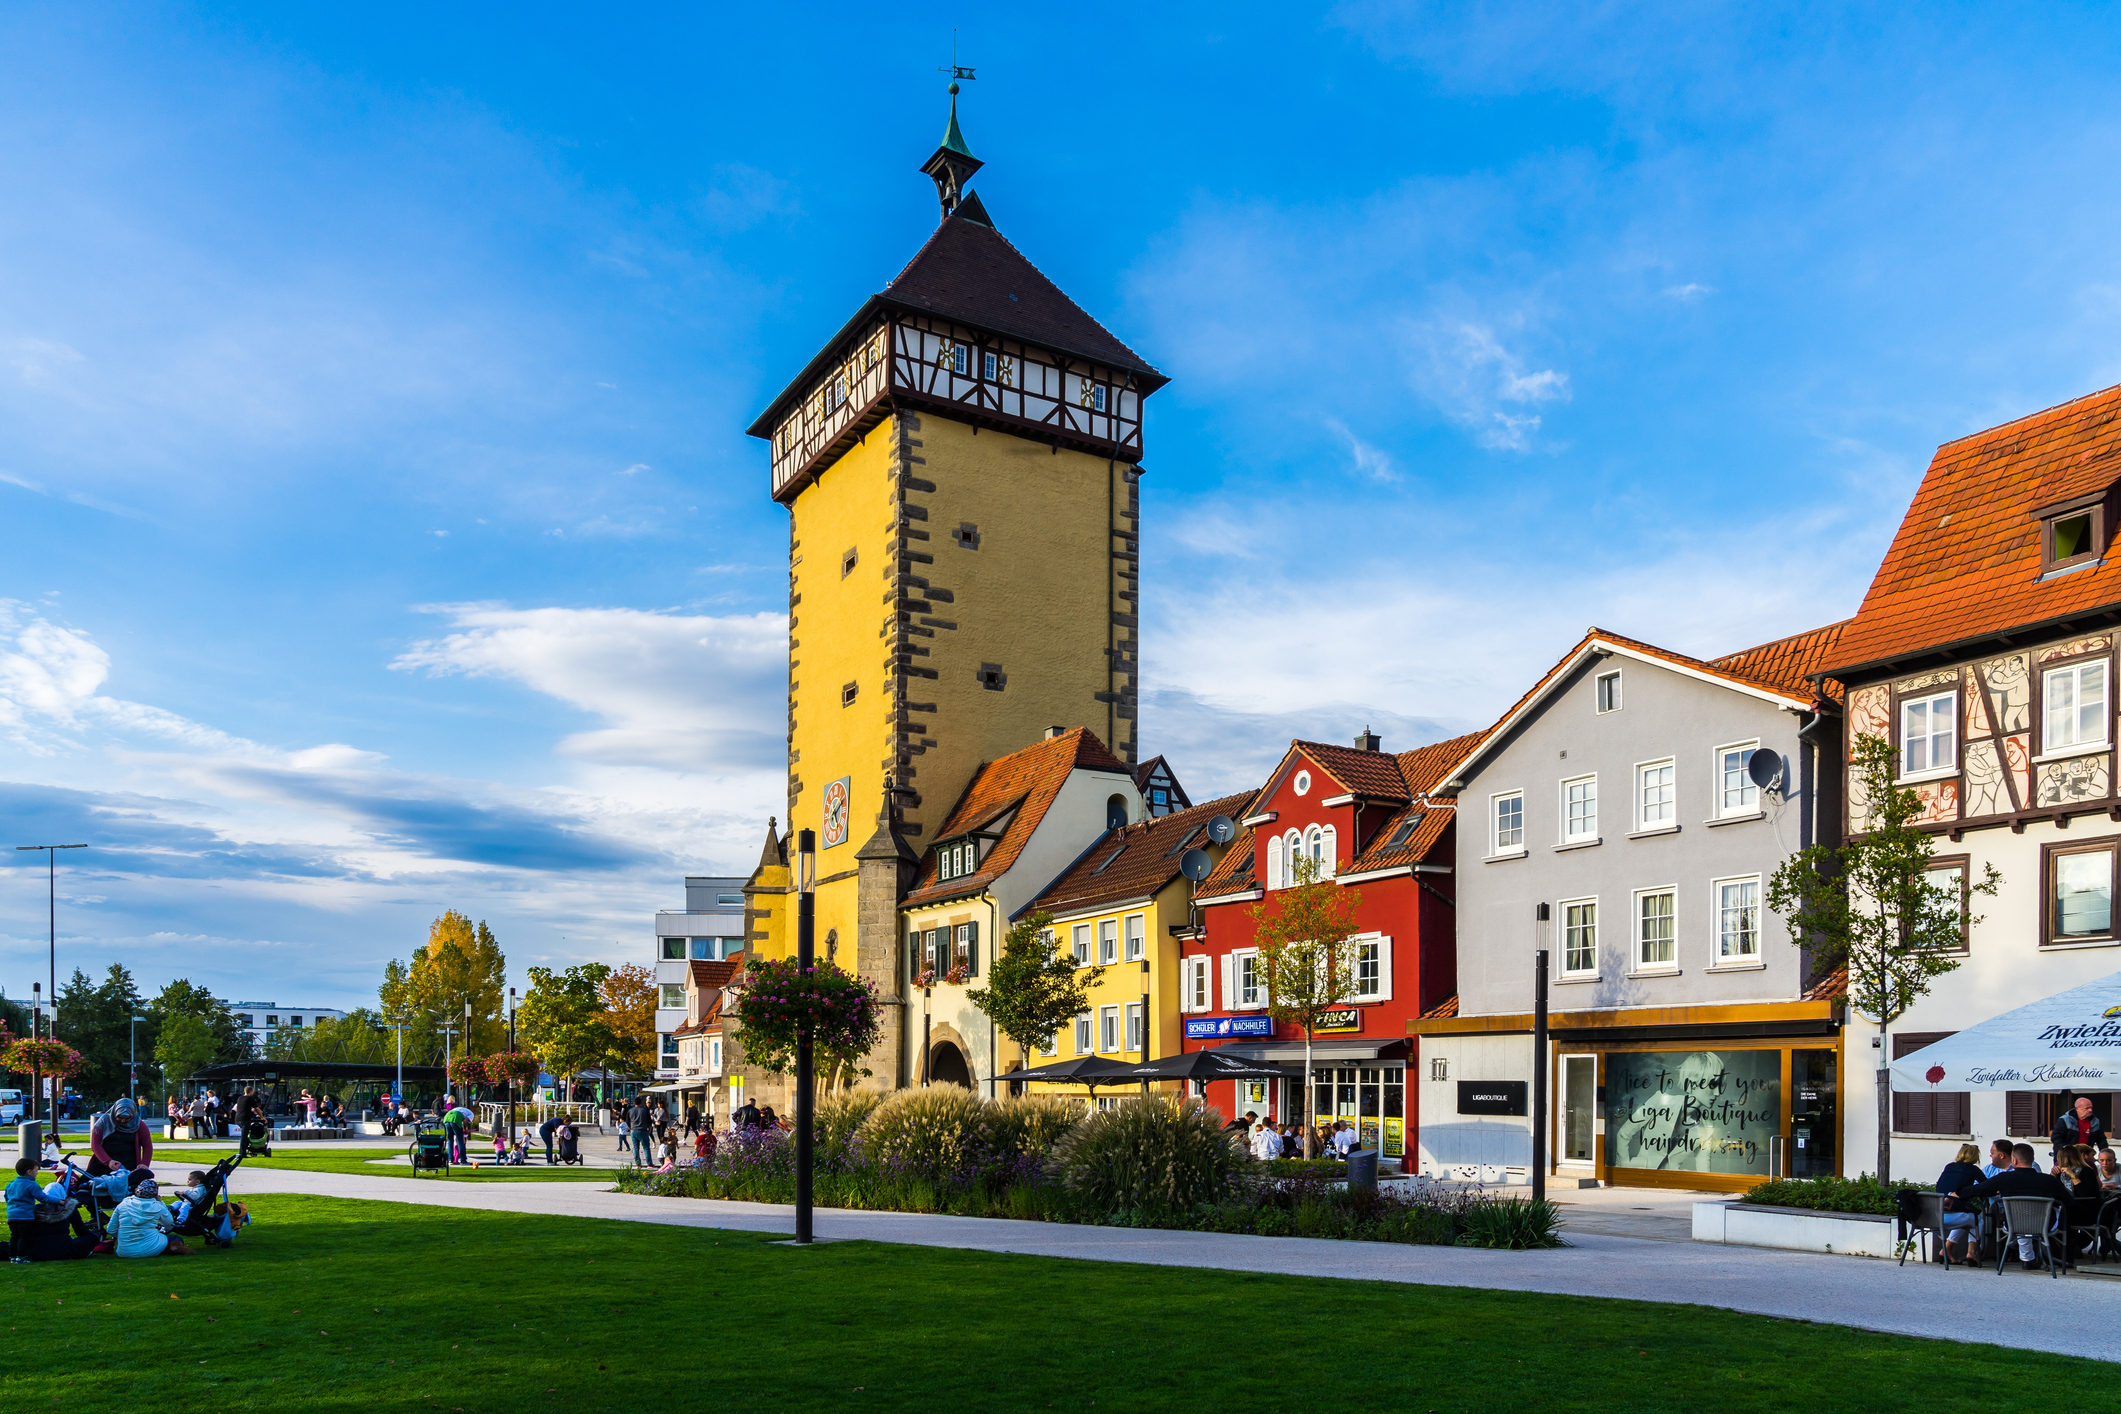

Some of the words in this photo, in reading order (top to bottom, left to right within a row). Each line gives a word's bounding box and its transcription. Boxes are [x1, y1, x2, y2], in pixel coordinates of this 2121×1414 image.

[1188, 1023, 1215, 1033] SCHÜLER
[1233, 1021, 1267, 1031] NACHHILFE
[1314, 1010, 1356, 1023] FINCA
[2036, 1020, 2121, 1040] Zwiefa
[1965, 1067, 2021, 1086] Zwiefalter
[2023, 1063, 2103, 1083] Klosterbräu
[1614, 1068, 1652, 1095] Nice
[1655, 1069, 1674, 1094] to
[1684, 1068, 1731, 1094] meet
[1736, 1077, 1774, 1106] you
[1681, 1094, 1773, 1131] Boutique
[1639, 1127, 1759, 1165] hairdressing
